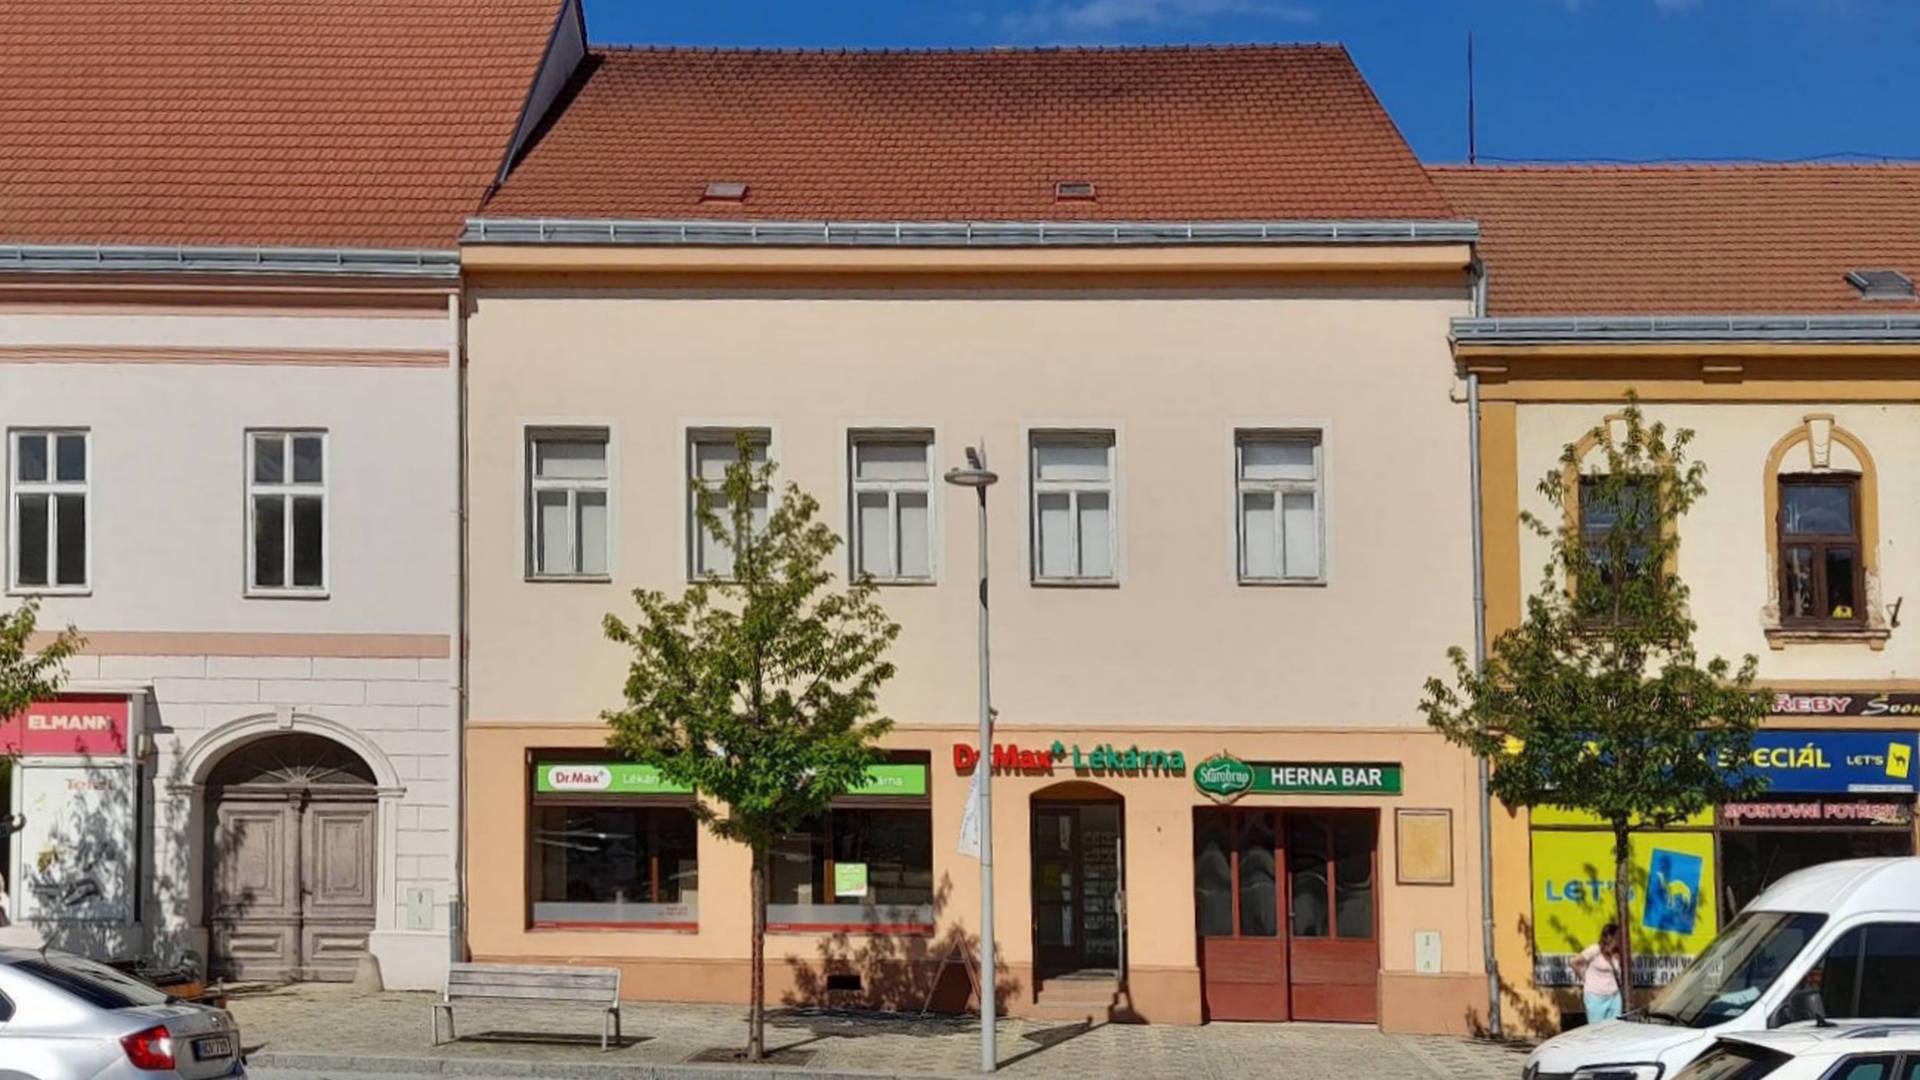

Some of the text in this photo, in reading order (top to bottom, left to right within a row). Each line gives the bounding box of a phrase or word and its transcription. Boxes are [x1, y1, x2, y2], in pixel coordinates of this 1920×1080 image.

[1771, 693, 1852, 713] ŘEBY
[28, 714, 113, 731] ELMANN
[1072, 745, 1186, 770] Lékárna
[1716, 743, 1832, 768] SECIÁL
[1271, 768, 1383, 786] HERNA BAR
[1724, 801, 1821, 819] SPORTOVNÍ
